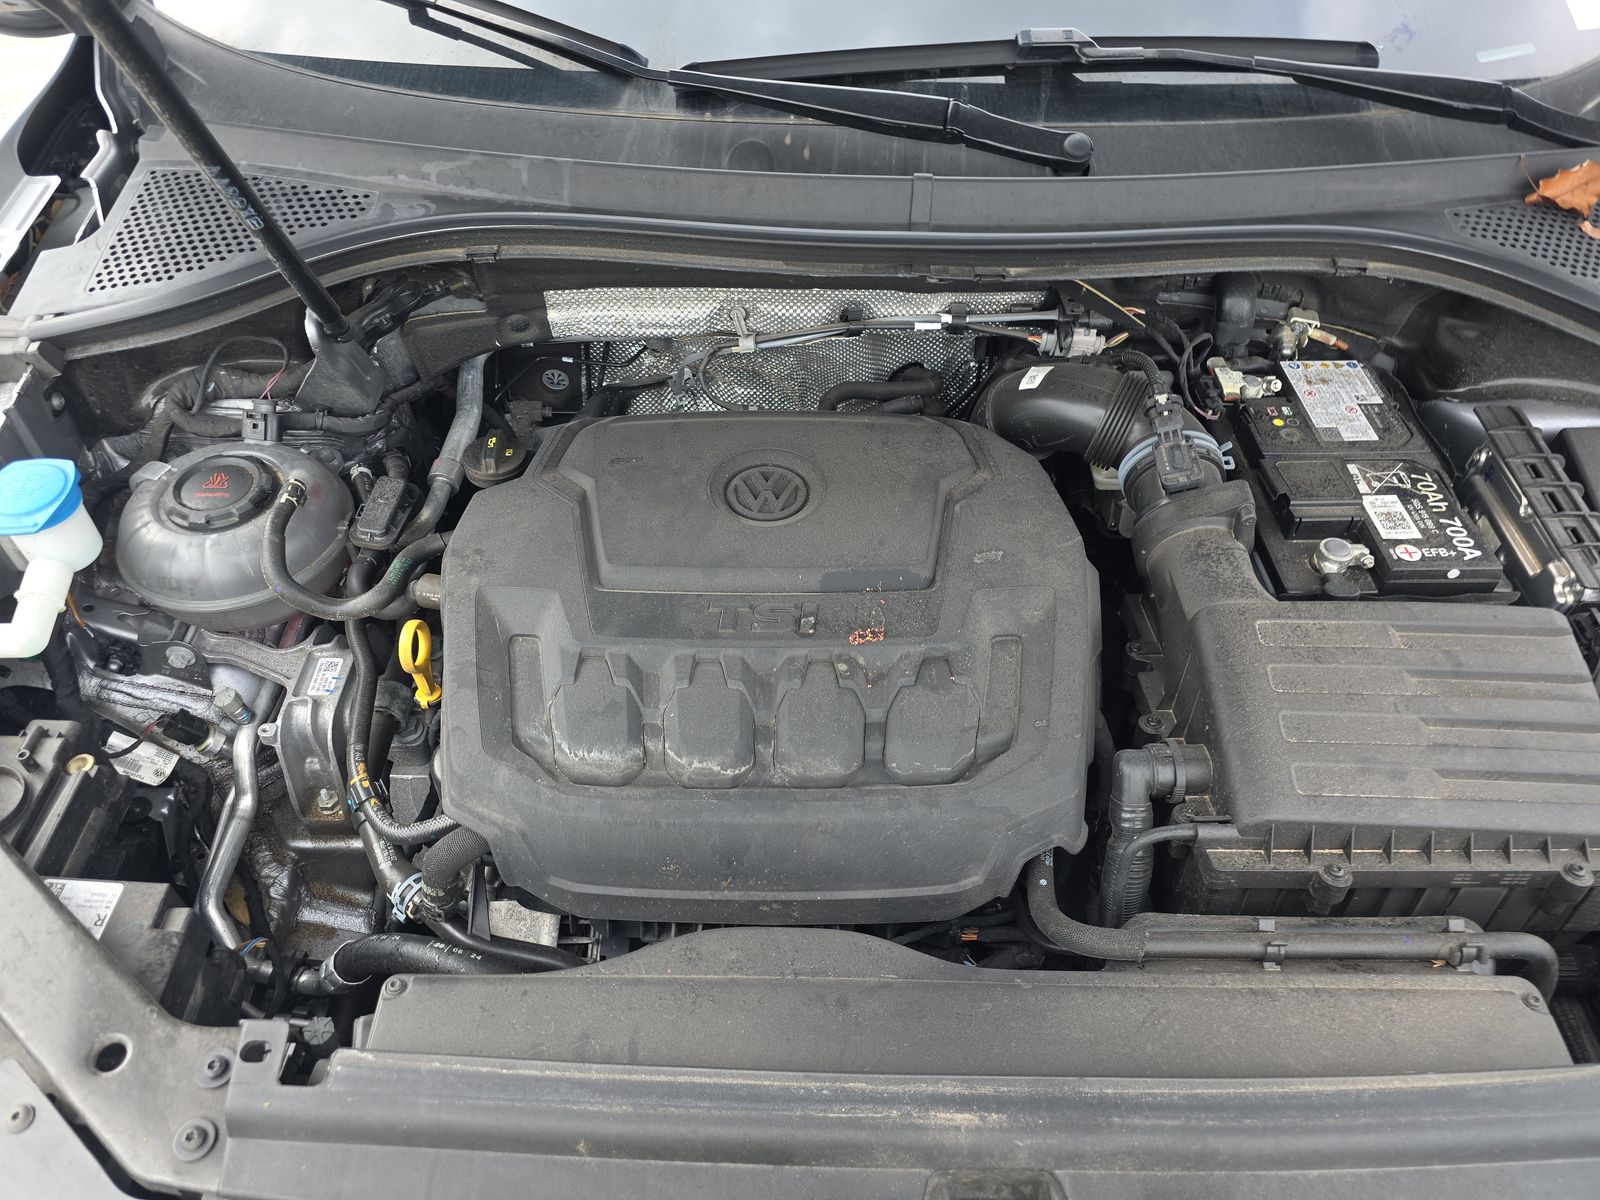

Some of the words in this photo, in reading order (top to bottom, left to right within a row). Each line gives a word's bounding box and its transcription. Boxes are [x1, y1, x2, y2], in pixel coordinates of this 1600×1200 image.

[725, 464, 809, 520] VW
[1410, 472, 1448, 512] 70Ah
[1439, 516, 1482, 561] 700A
[1422, 547, 1457, 557] EFB+
[707, 601, 819, 633] TSI
